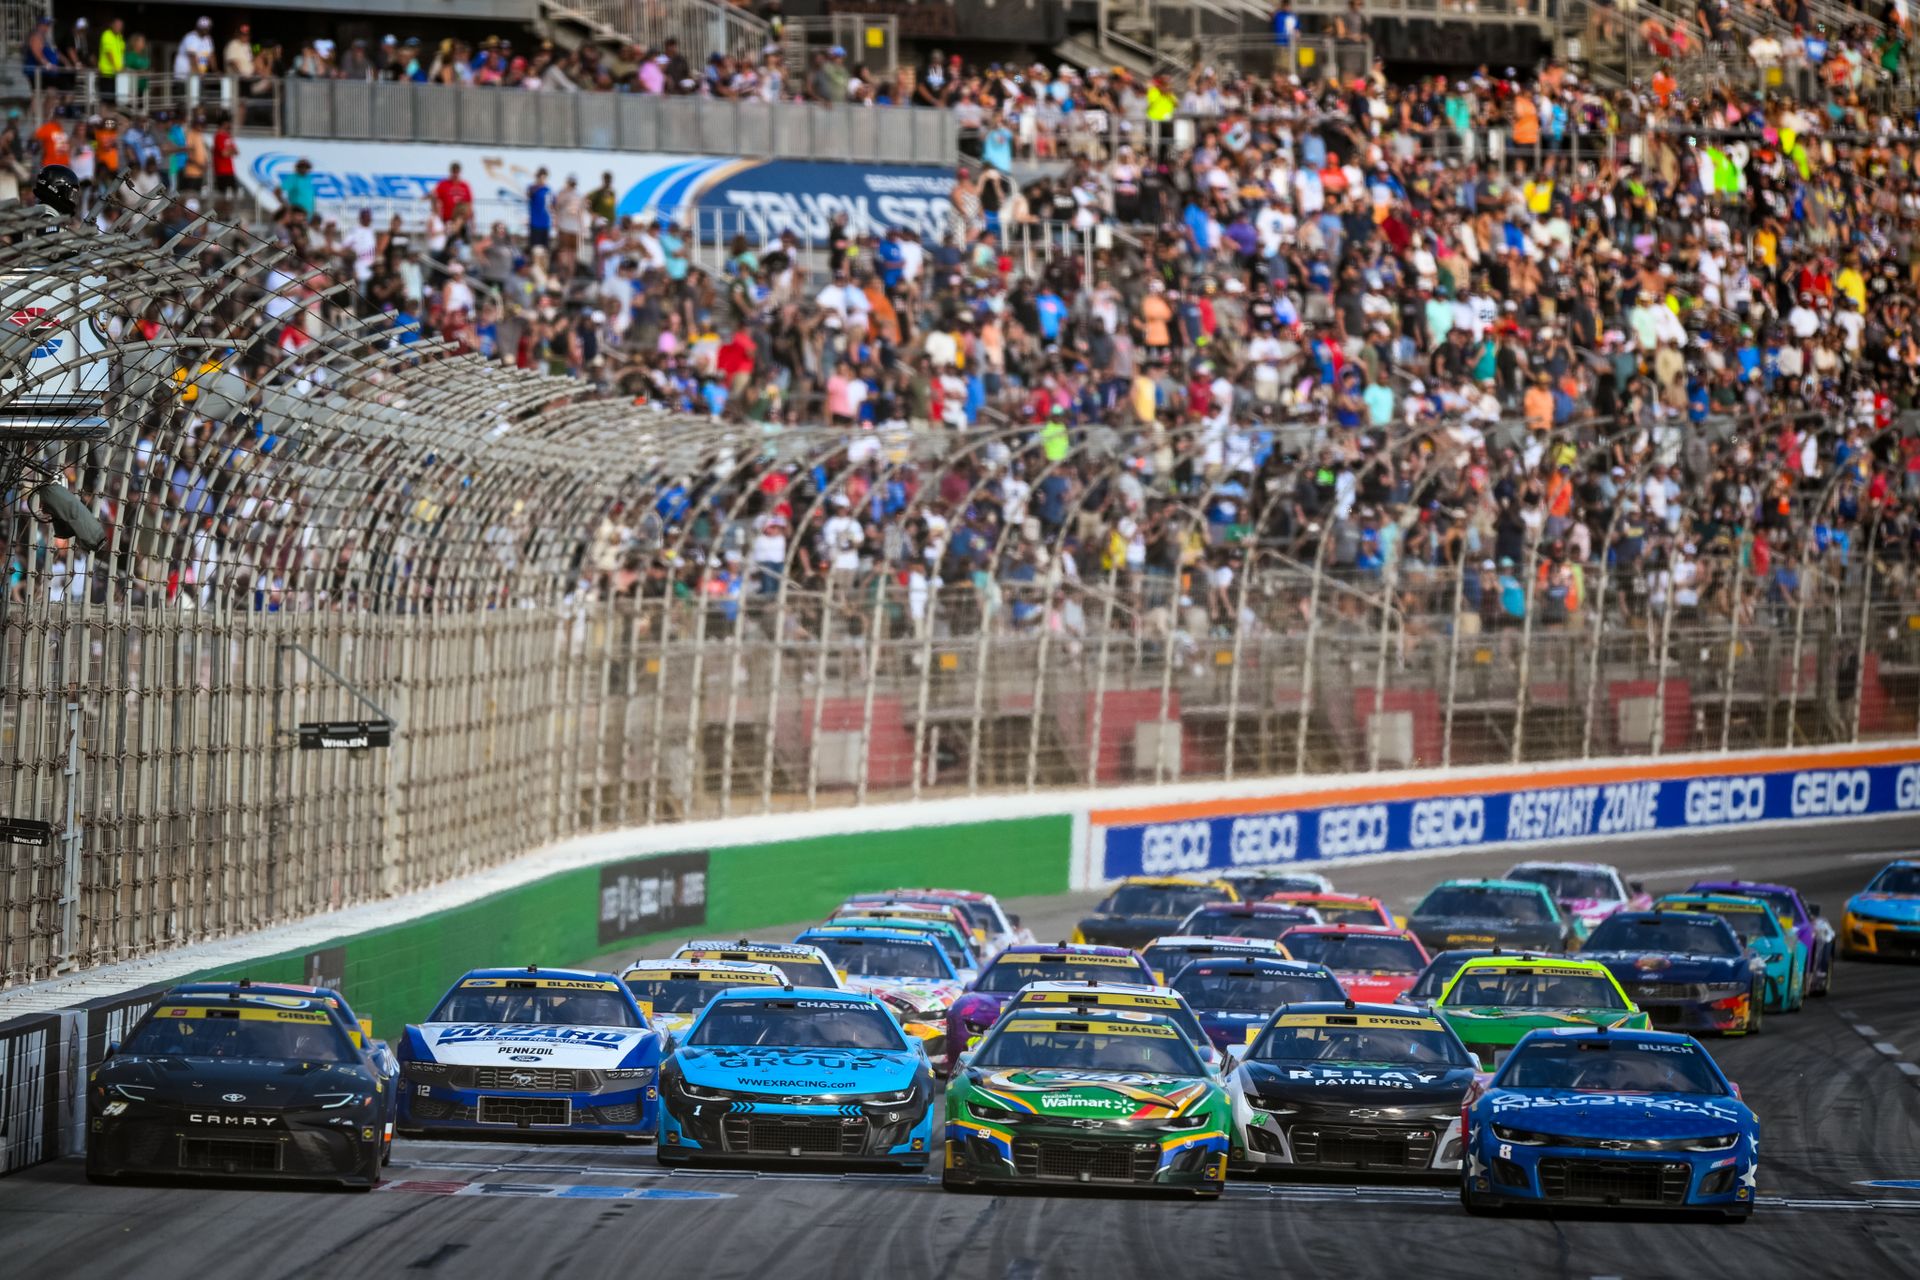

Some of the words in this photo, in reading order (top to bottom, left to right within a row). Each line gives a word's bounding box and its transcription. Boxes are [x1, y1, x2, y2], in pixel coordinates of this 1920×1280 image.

[321, 736, 368, 748] WHELEN
[1791, 769, 1870, 816] GEICO
[1684, 776, 1766, 825] GEICO
[1506, 786, 1600, 841] RESTART
[1599, 781, 1661, 833] ZONE
[1409, 797, 1485, 849] GEICO
[1318, 805, 1389, 856] GEICO
[1230, 813, 1299, 864] GEICO
[1142, 821, 1211, 874] GEICO
[1213, 946, 1266, 954] STENHOUSE
[755, 952, 810, 961] REDDICK
[1069, 956, 1128, 965] BOWMAN
[711, 973, 766, 982] ELLIOTT
[1542, 968, 1593, 976] CINDRIC
[547, 980, 605, 990] BLANEY
[796, 1001, 878, 1011] CHASTAIN
[1134, 997, 1172, 1007] BELL
[276, 1010, 327, 1023] GIBBS
[1368, 1017, 1422, 1026] BYRON
[439, 1026, 629, 1043] WIZARD
[1107, 1023, 1174, 1036] SUÁREZ
[528, 1037, 587, 1045] REPAIRS
[498, 1046, 554, 1056] PENNZOIL
[1638, 1044, 1694, 1055] BUSCH
[719, 1056, 876, 1071] GROUP
[1289, 1069, 1437, 1084] RELAY
[737, 1077, 856, 1090] WWEXRACING.com
[1315, 1078, 1415, 1090] PAYMENTS
[417, 1084, 431, 1097] 12
[1041, 1098, 1112, 1109] Walmart
[693, 1105, 702, 1116] 1
[190, 1114, 278, 1126] CAMRY
[1251, 1113, 1269, 1126] 24
[977, 1128, 991, 1140] 99
[1500, 1144, 1512, 1160] 8
